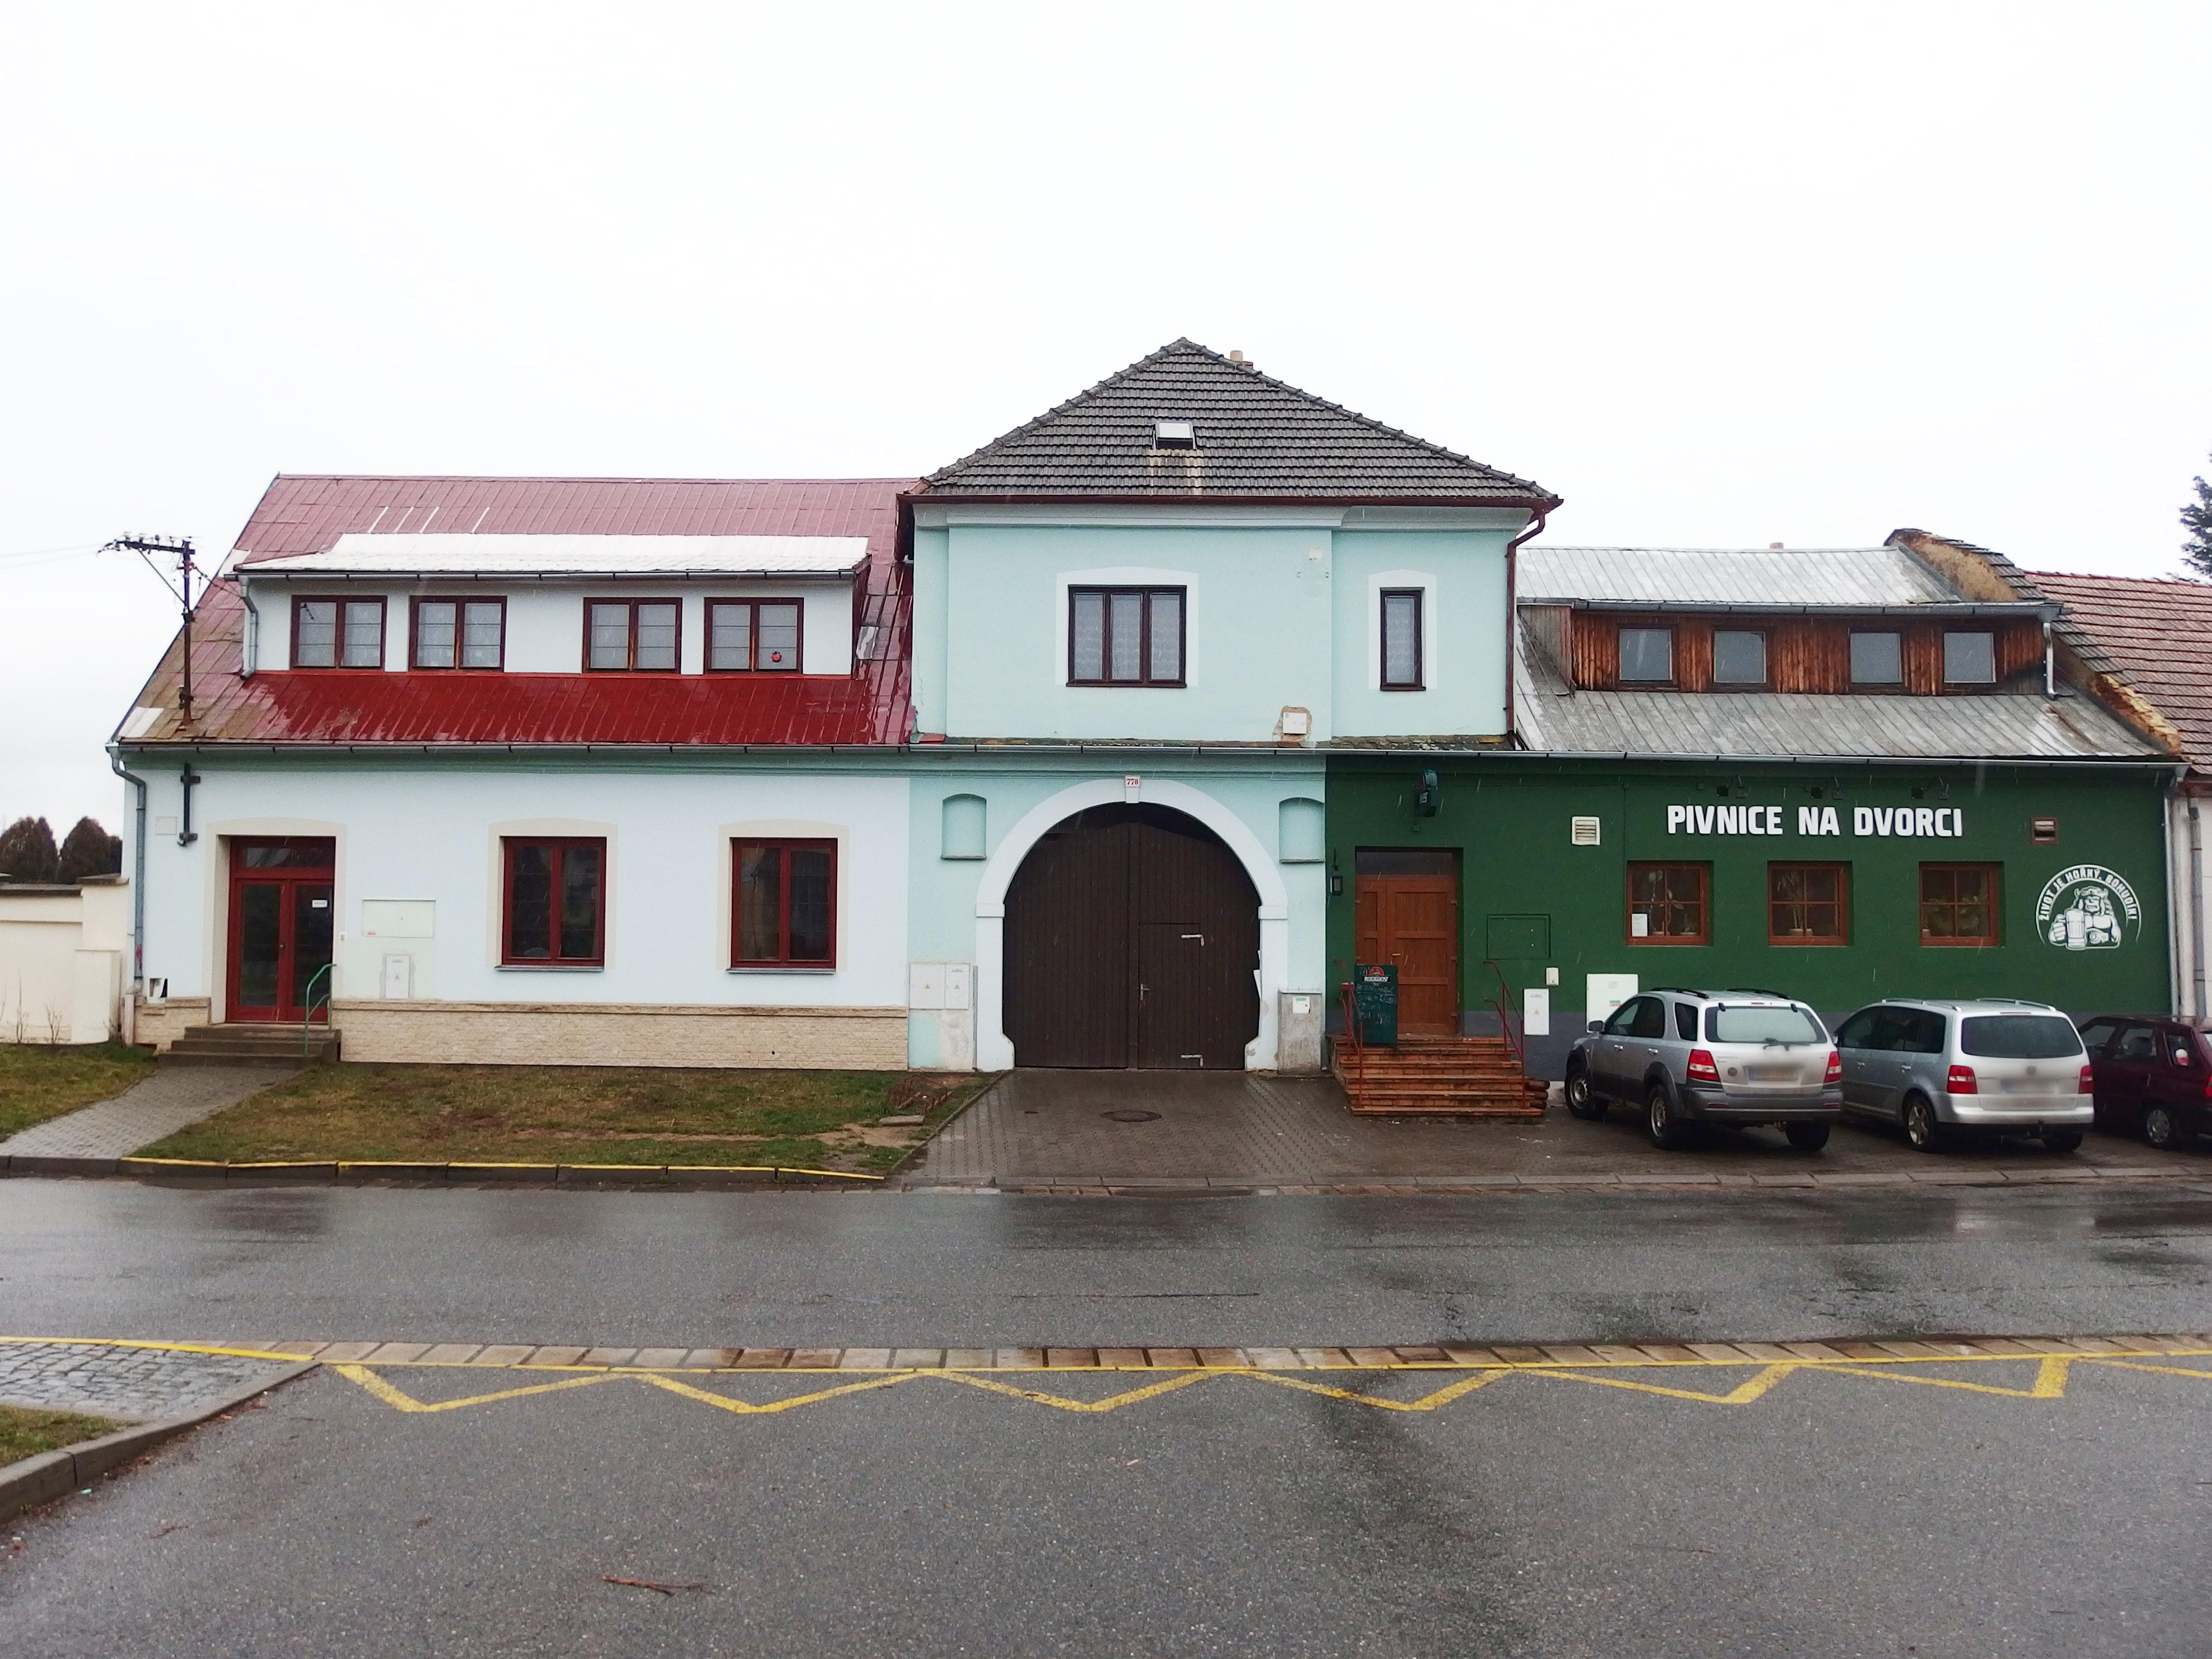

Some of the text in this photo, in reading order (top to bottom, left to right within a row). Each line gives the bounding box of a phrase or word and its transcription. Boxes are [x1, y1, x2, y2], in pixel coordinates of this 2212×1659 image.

[1667, 805, 1963, 837] PIVNICE NA DVORCI
[2053, 877, 2066, 892] JE
